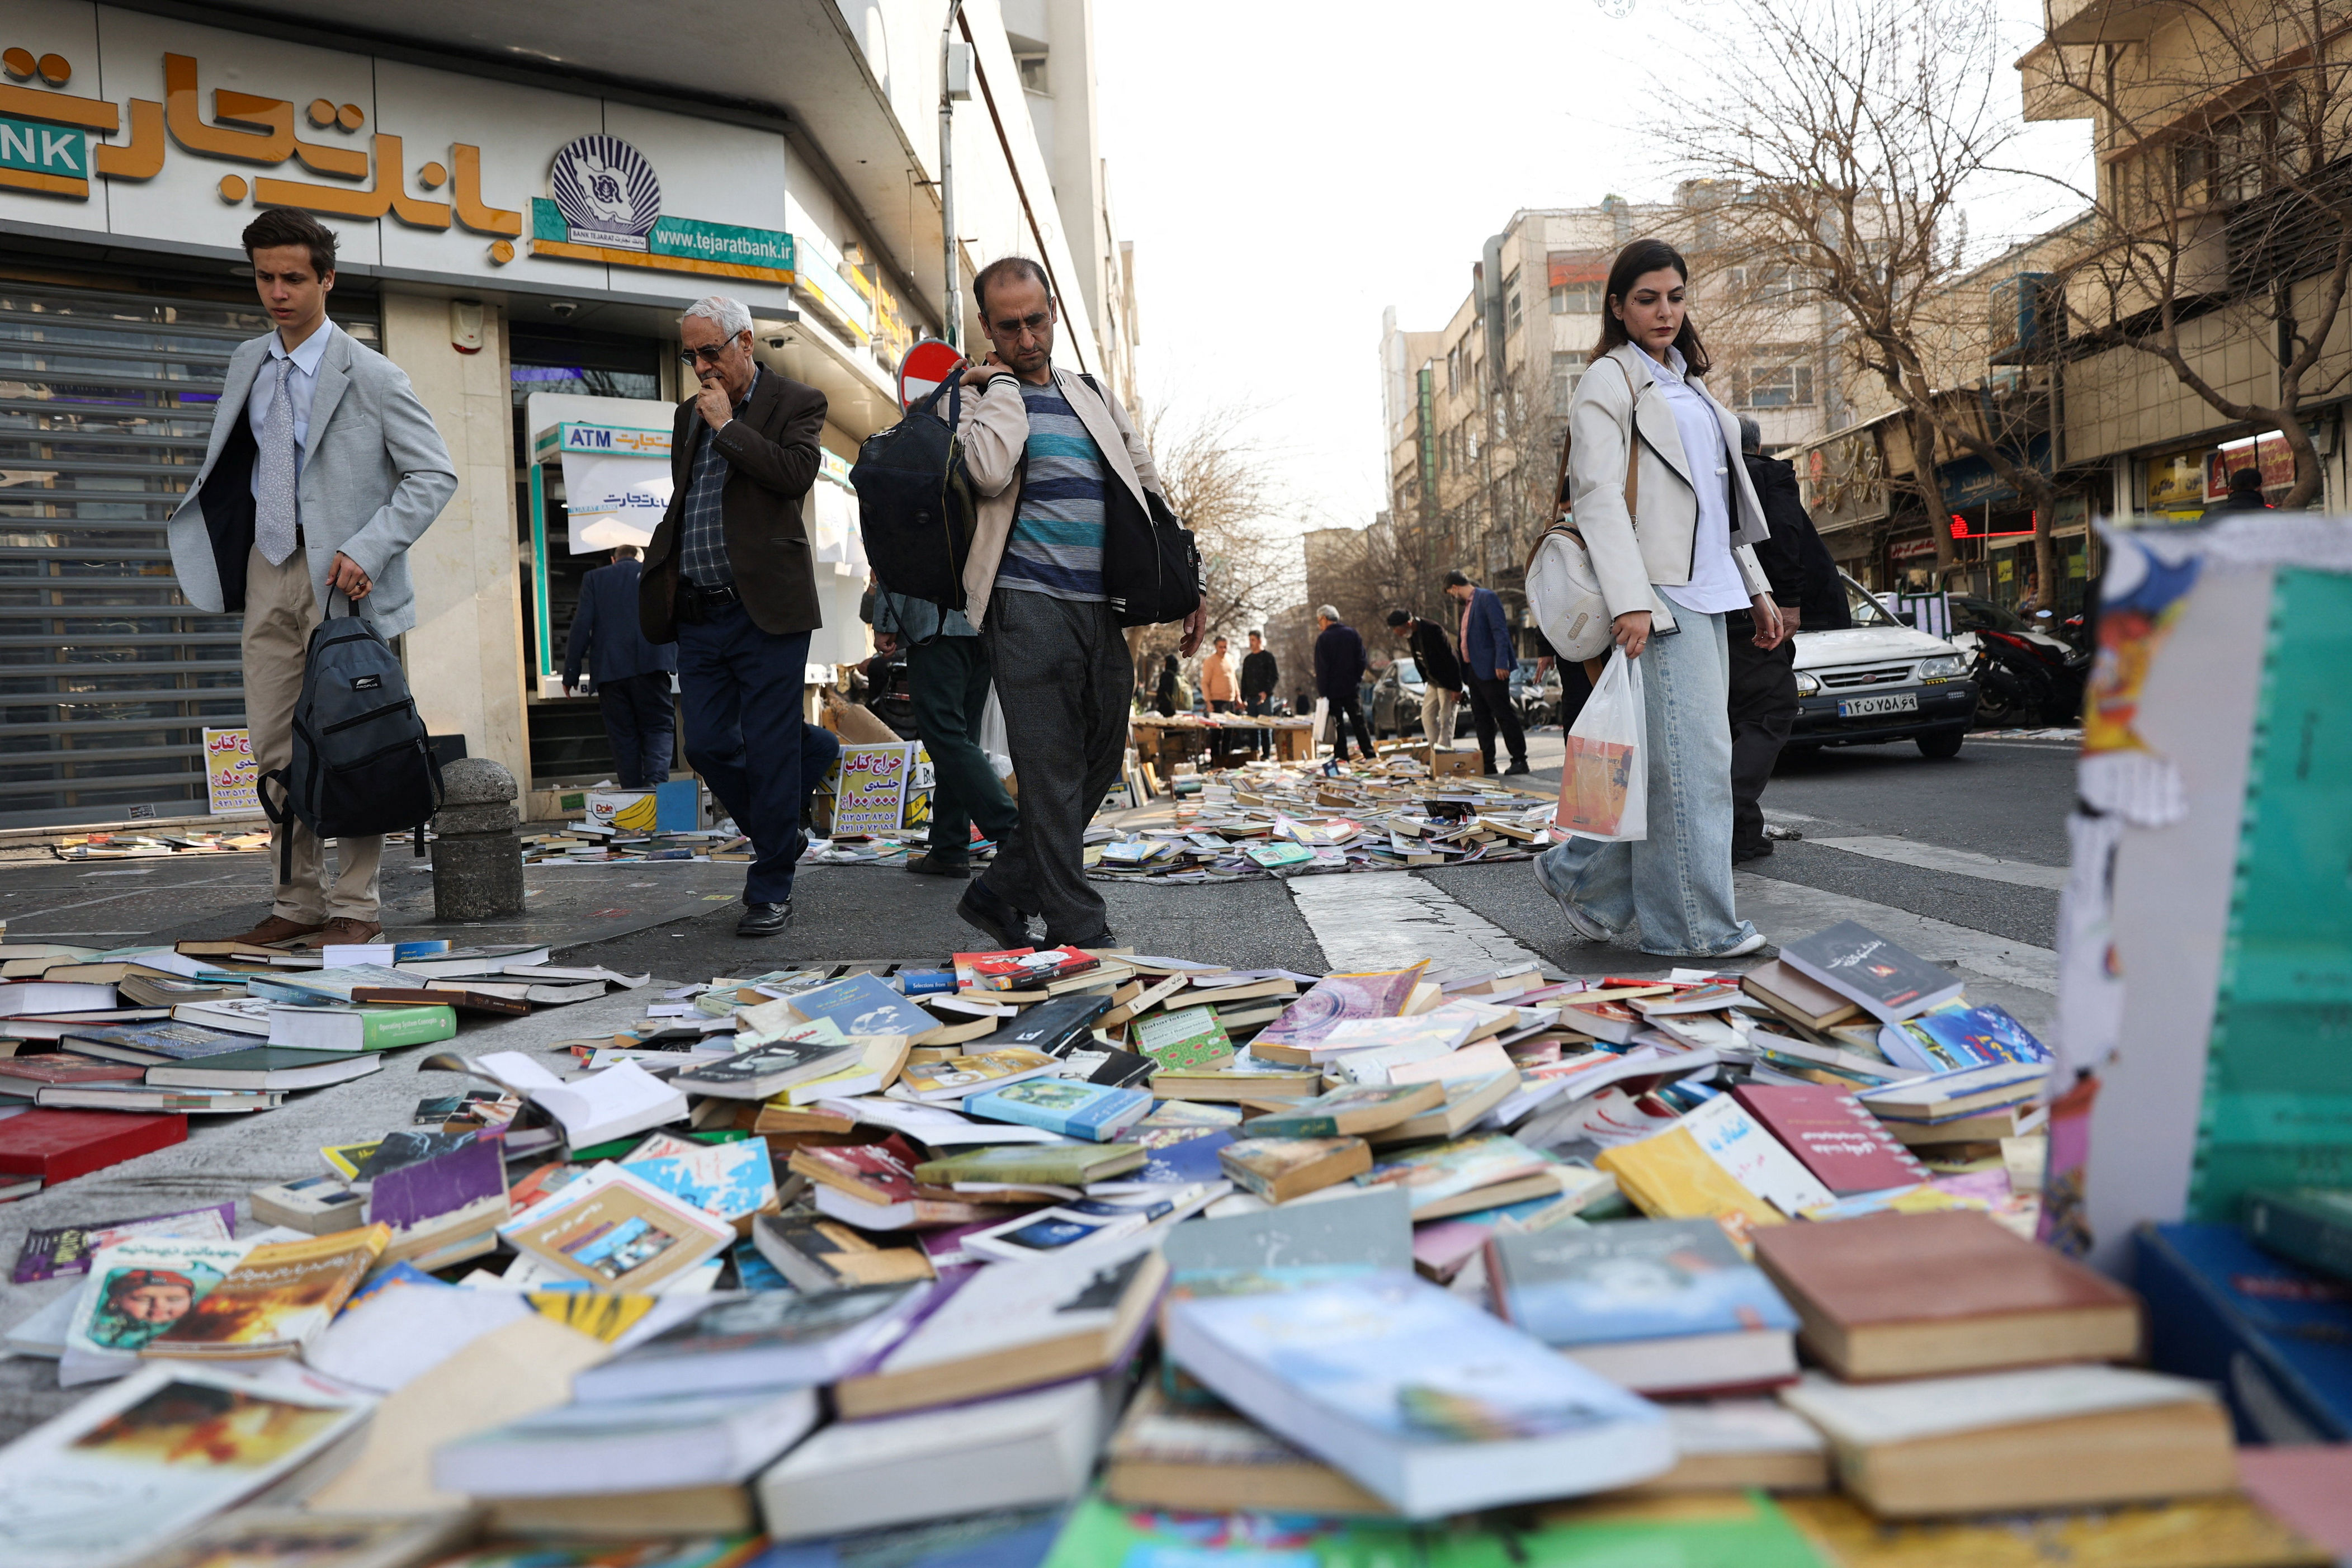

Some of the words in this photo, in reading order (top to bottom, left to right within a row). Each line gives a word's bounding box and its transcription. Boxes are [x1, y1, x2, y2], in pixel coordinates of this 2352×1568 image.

[0, 47, 368, 205] تجارت
[253, 133, 522, 267] بانک
[589, 232, 614, 241] TEJARAT
[656, 229, 791, 259] www.tejaratbank.ir
[570, 428, 611, 447] ATM
[210, 734, 237, 755] کتاب
[845, 753, 873, 776] کتاب
[872, 753, 902, 774] حراج
[864, 778, 899, 792] جلدی
[596, 804, 613, 813] Dole
[379, 1022, 402, 1031] Operating
